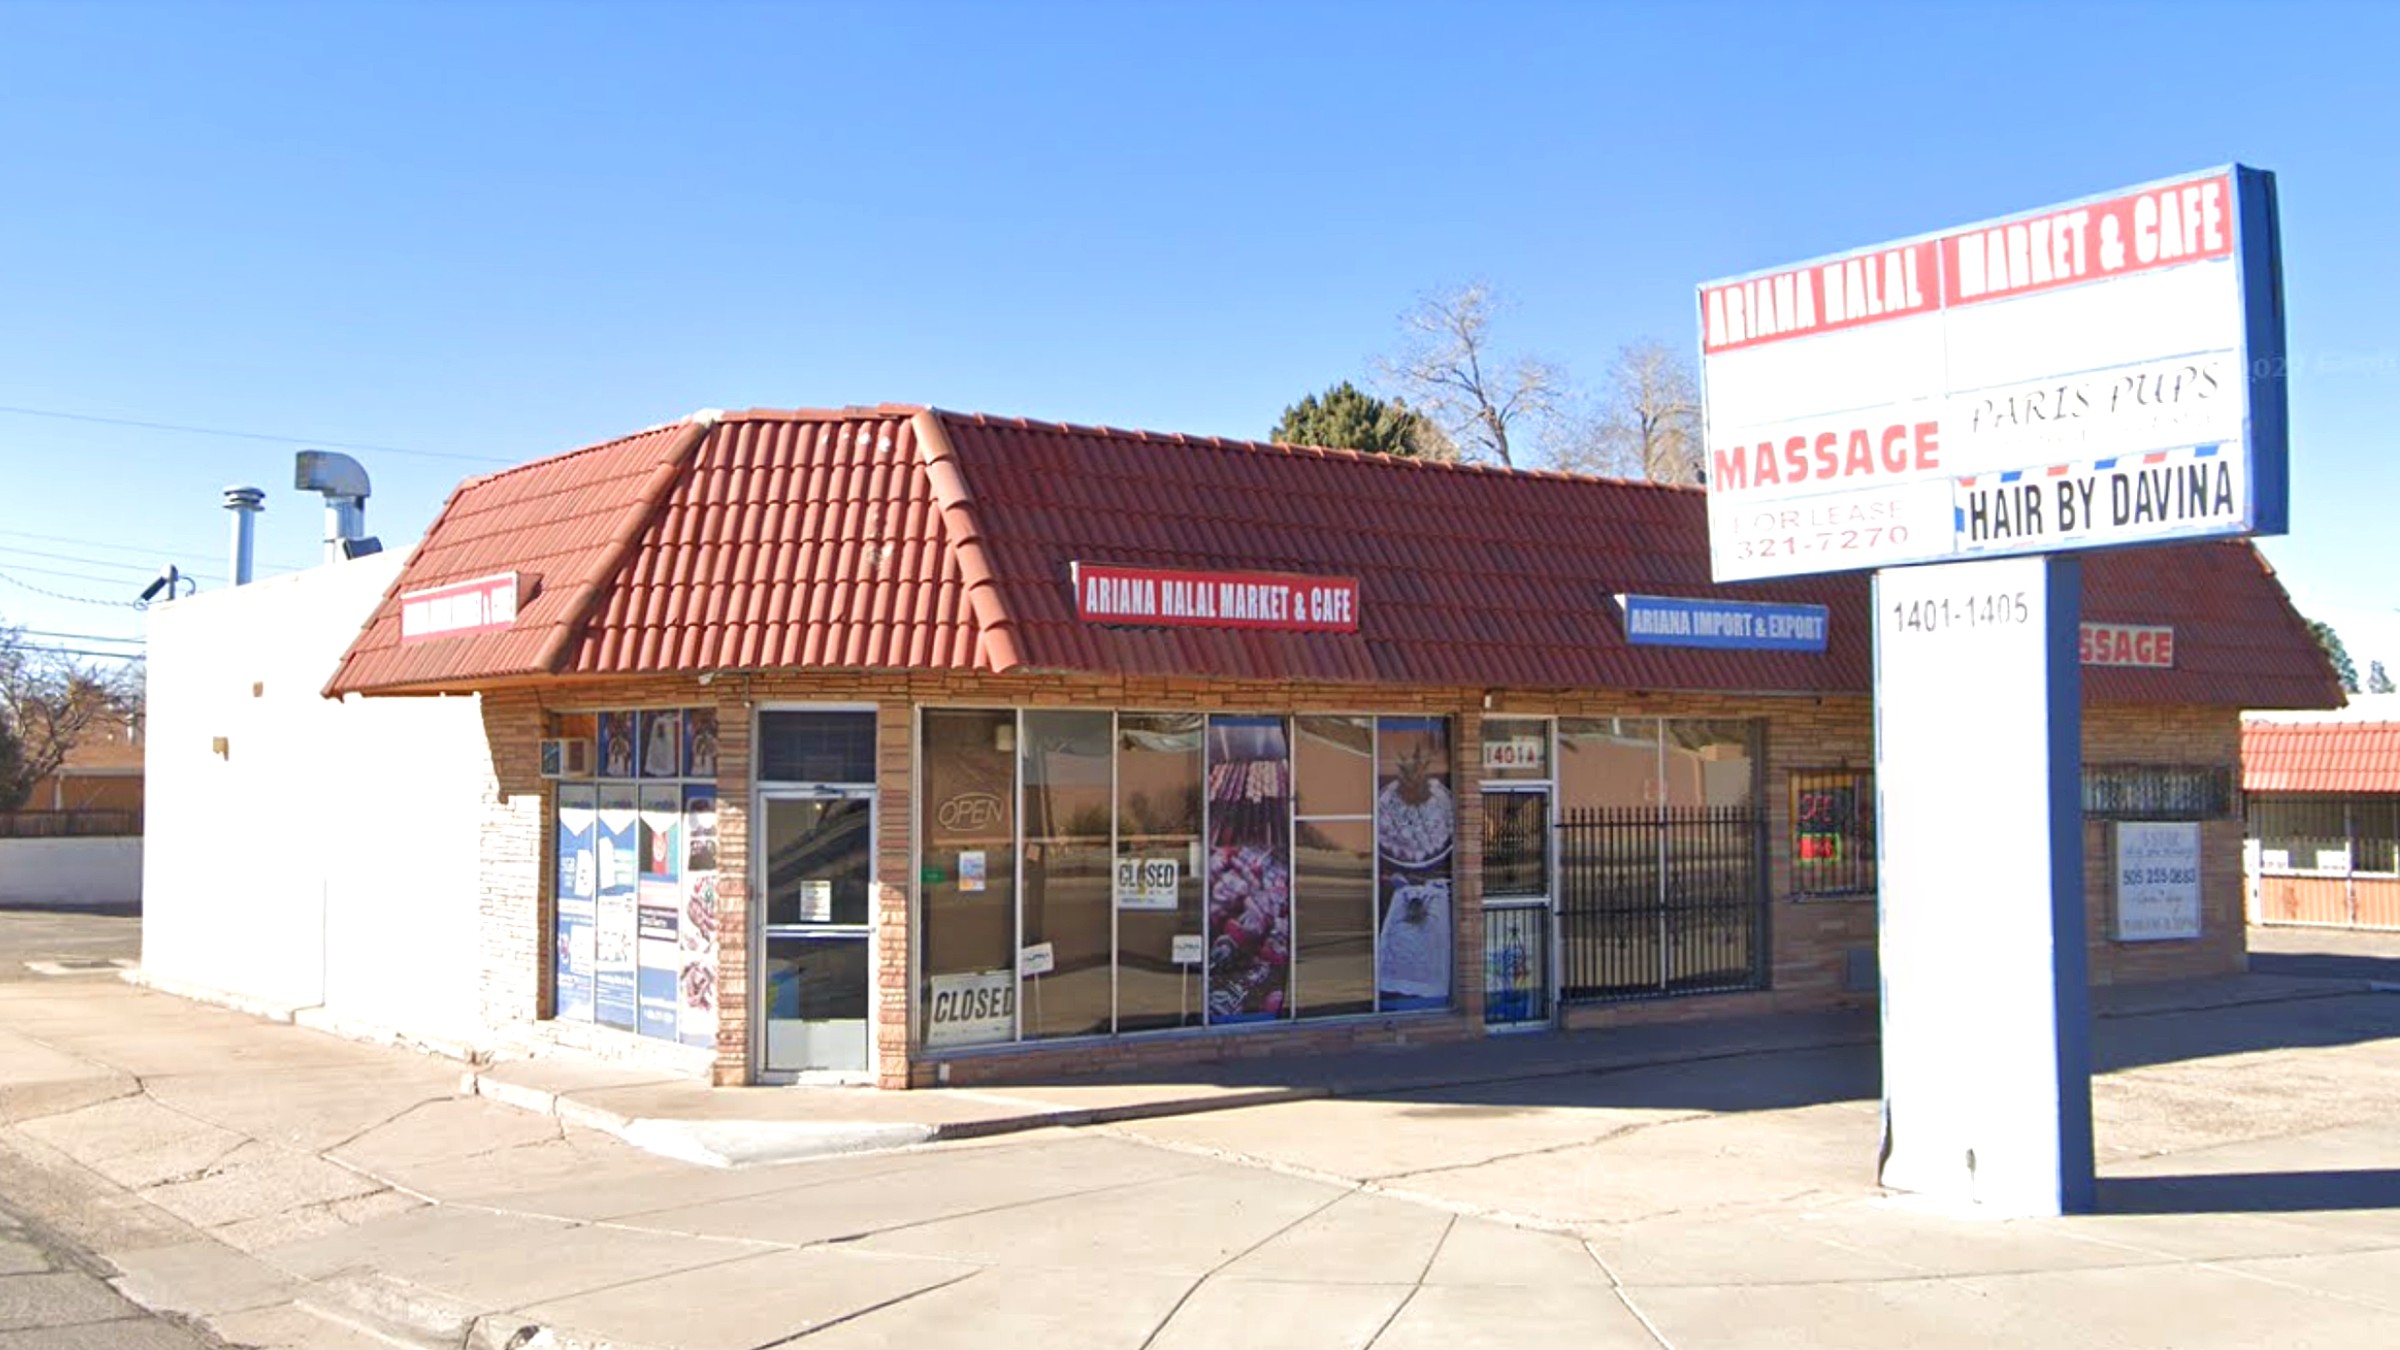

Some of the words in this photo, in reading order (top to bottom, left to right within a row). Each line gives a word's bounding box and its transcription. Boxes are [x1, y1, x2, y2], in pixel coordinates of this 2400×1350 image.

[1709, 271, 1816, 347] ARIANA
[1825, 248, 1922, 323] HALAL
[1958, 211, 2090, 298] MARKET
[2101, 215, 2124, 268] &
[2135, 182, 2222, 263] CAFE
[1972, 383, 2090, 434] PARIS
[2111, 361, 2219, 413] PUPS
[1714, 421, 1940, 492] MASSAGE
[1811, 500, 1904, 527] LEASE
[1970, 485, 2043, 541] HAIR
[2058, 479, 2097, 533] BY
[2112, 461, 2235, 526] DAVINA
[1737, 524, 1909, 560] 321-7270
[1086, 576, 1155, 614] ARIANA
[1162, 580, 1216, 618] HALAL
[1220, 583, 1289, 620] MARKET
[1294, 592, 1306, 621] &
[1311, 587, 1351, 623] CAFE
[1894, 592, 2028, 632] 1401-1405
[1631, 609, 1690, 635] ARIANA
[1693, 612, 1752, 637] IMPORT
[1755, 617, 1766, 638] &
[1769, 614, 1823, 640] EXPORT
[939, 799, 1004, 827] OPEN
[934, 987, 1014, 1024] CLOSED
